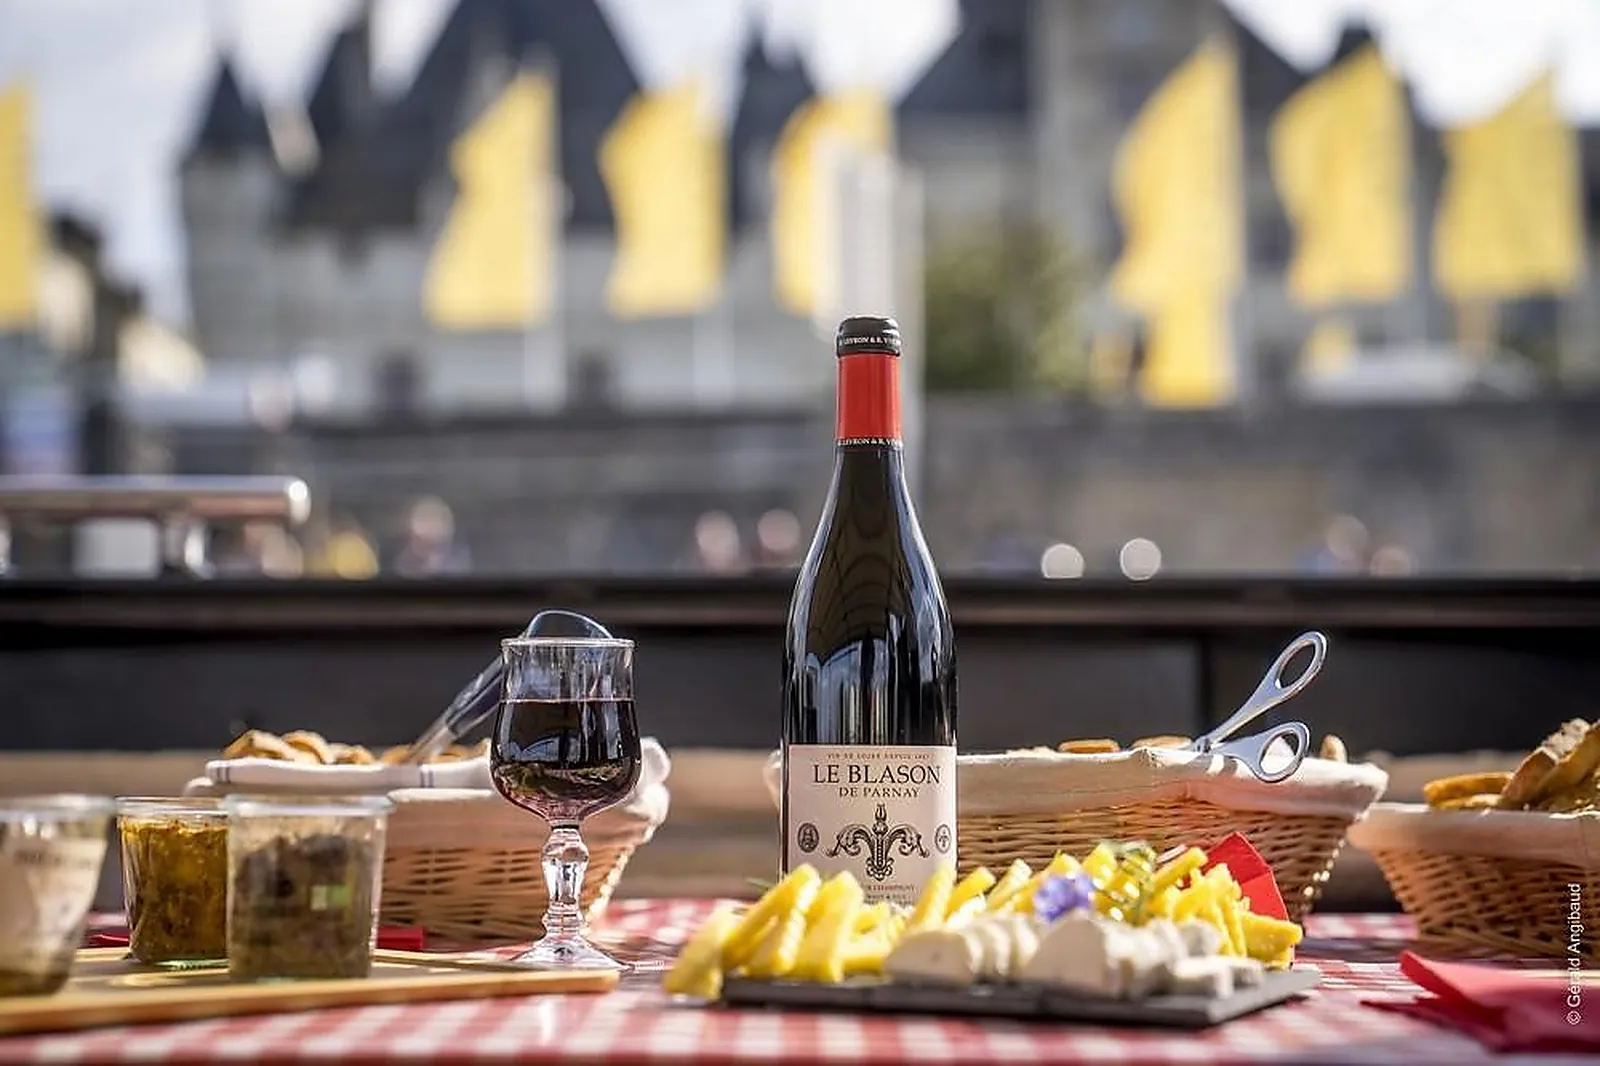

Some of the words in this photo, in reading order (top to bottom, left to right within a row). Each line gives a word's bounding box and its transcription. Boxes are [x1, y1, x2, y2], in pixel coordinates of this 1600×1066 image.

[813, 764, 840, 784] LE
[848, 764, 940, 784] BLASON
[839, 787, 858, 797] DE
[864, 787, 920, 797] PARNAY
